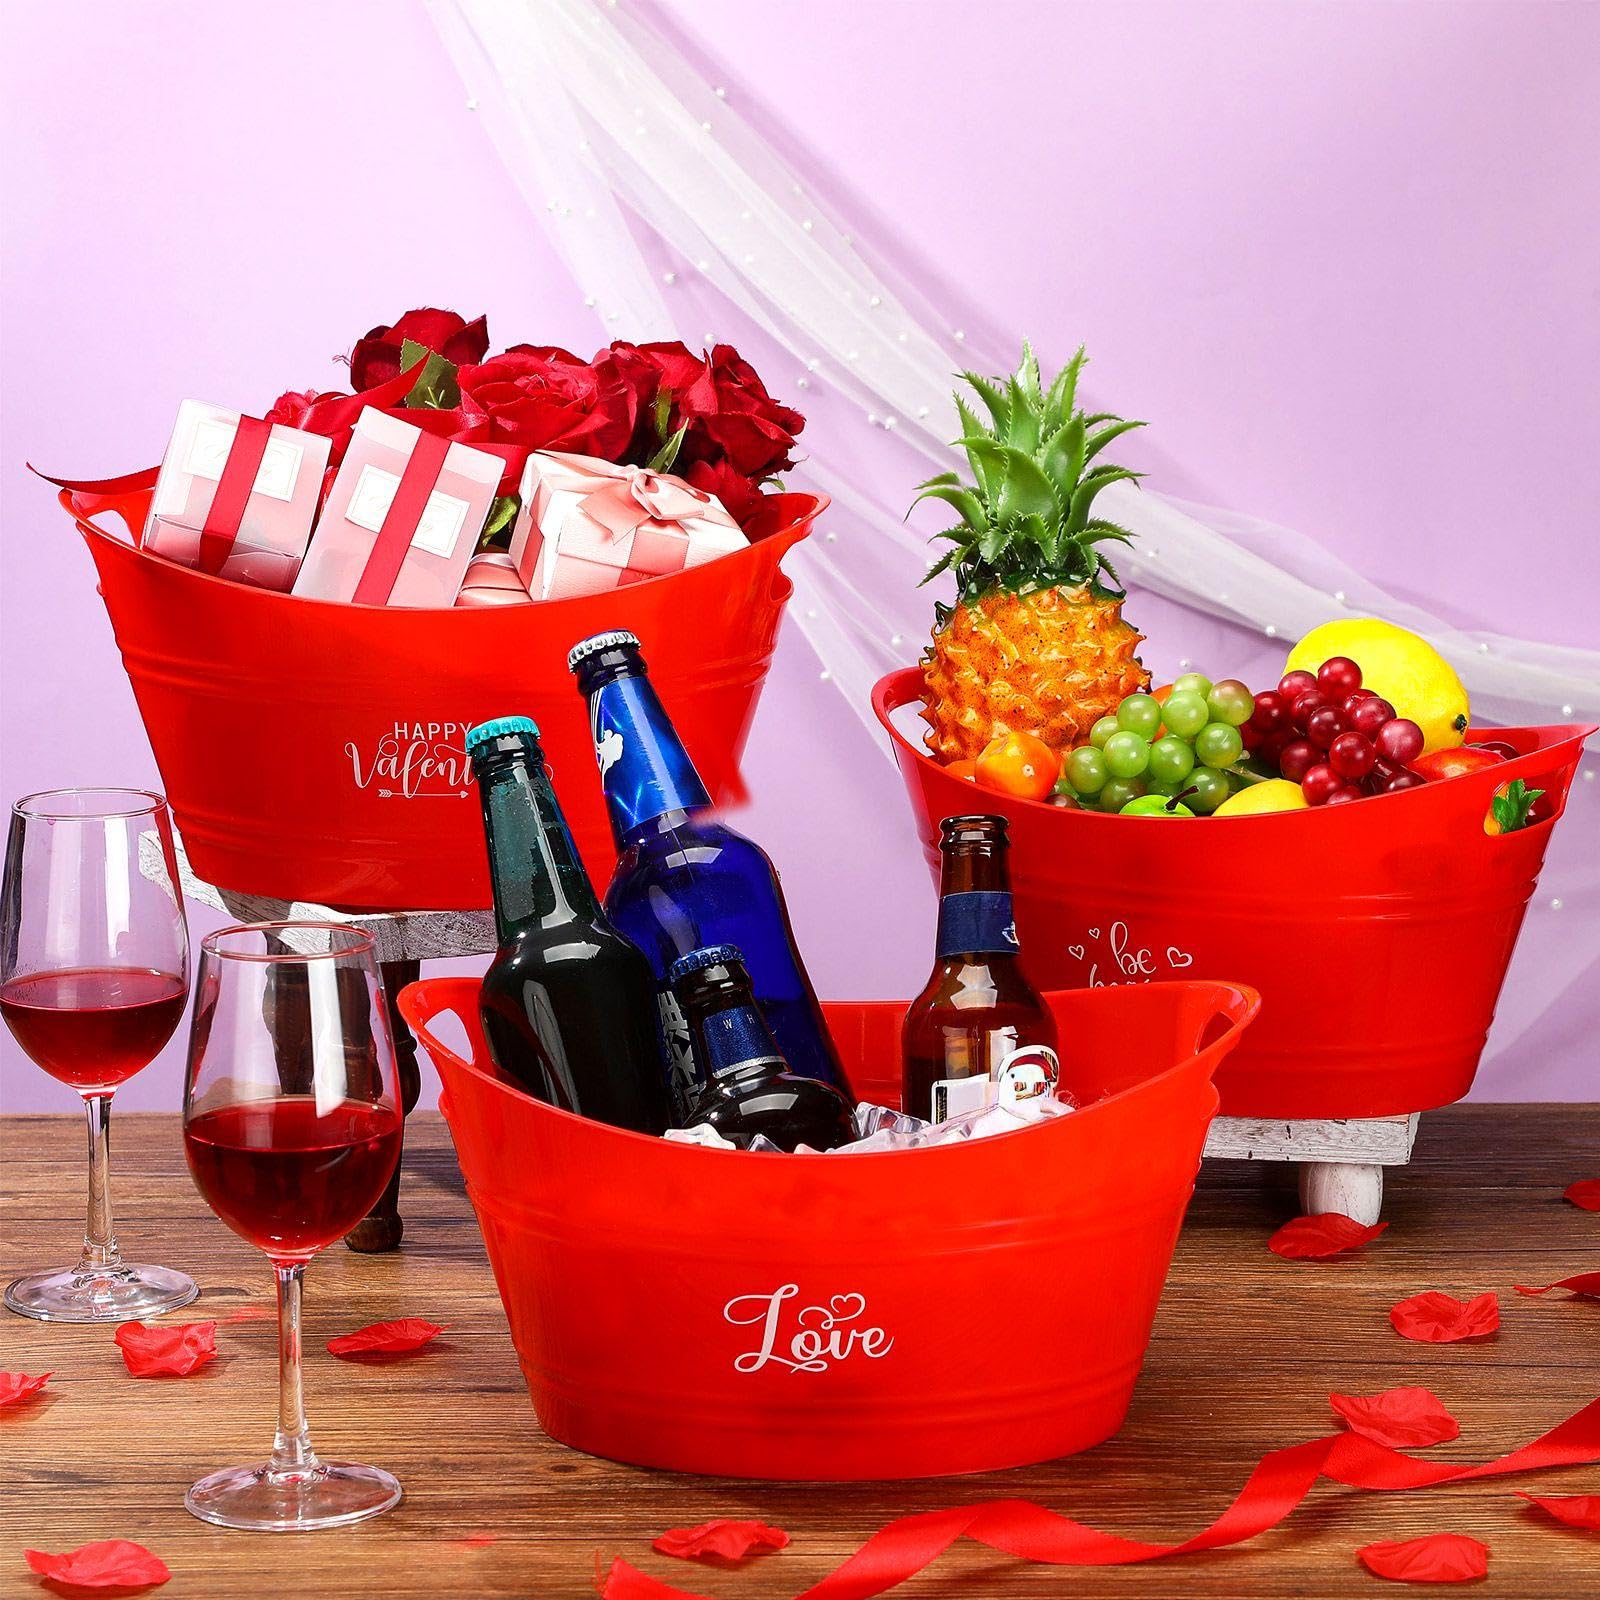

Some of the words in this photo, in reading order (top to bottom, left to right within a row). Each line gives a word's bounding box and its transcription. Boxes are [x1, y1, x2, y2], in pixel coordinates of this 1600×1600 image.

[394, 722, 473, 740] HAPPY
[344, 733, 476, 798] Valent
[1110, 921, 1157, 975] be
[723, 1283, 895, 1374] Love
